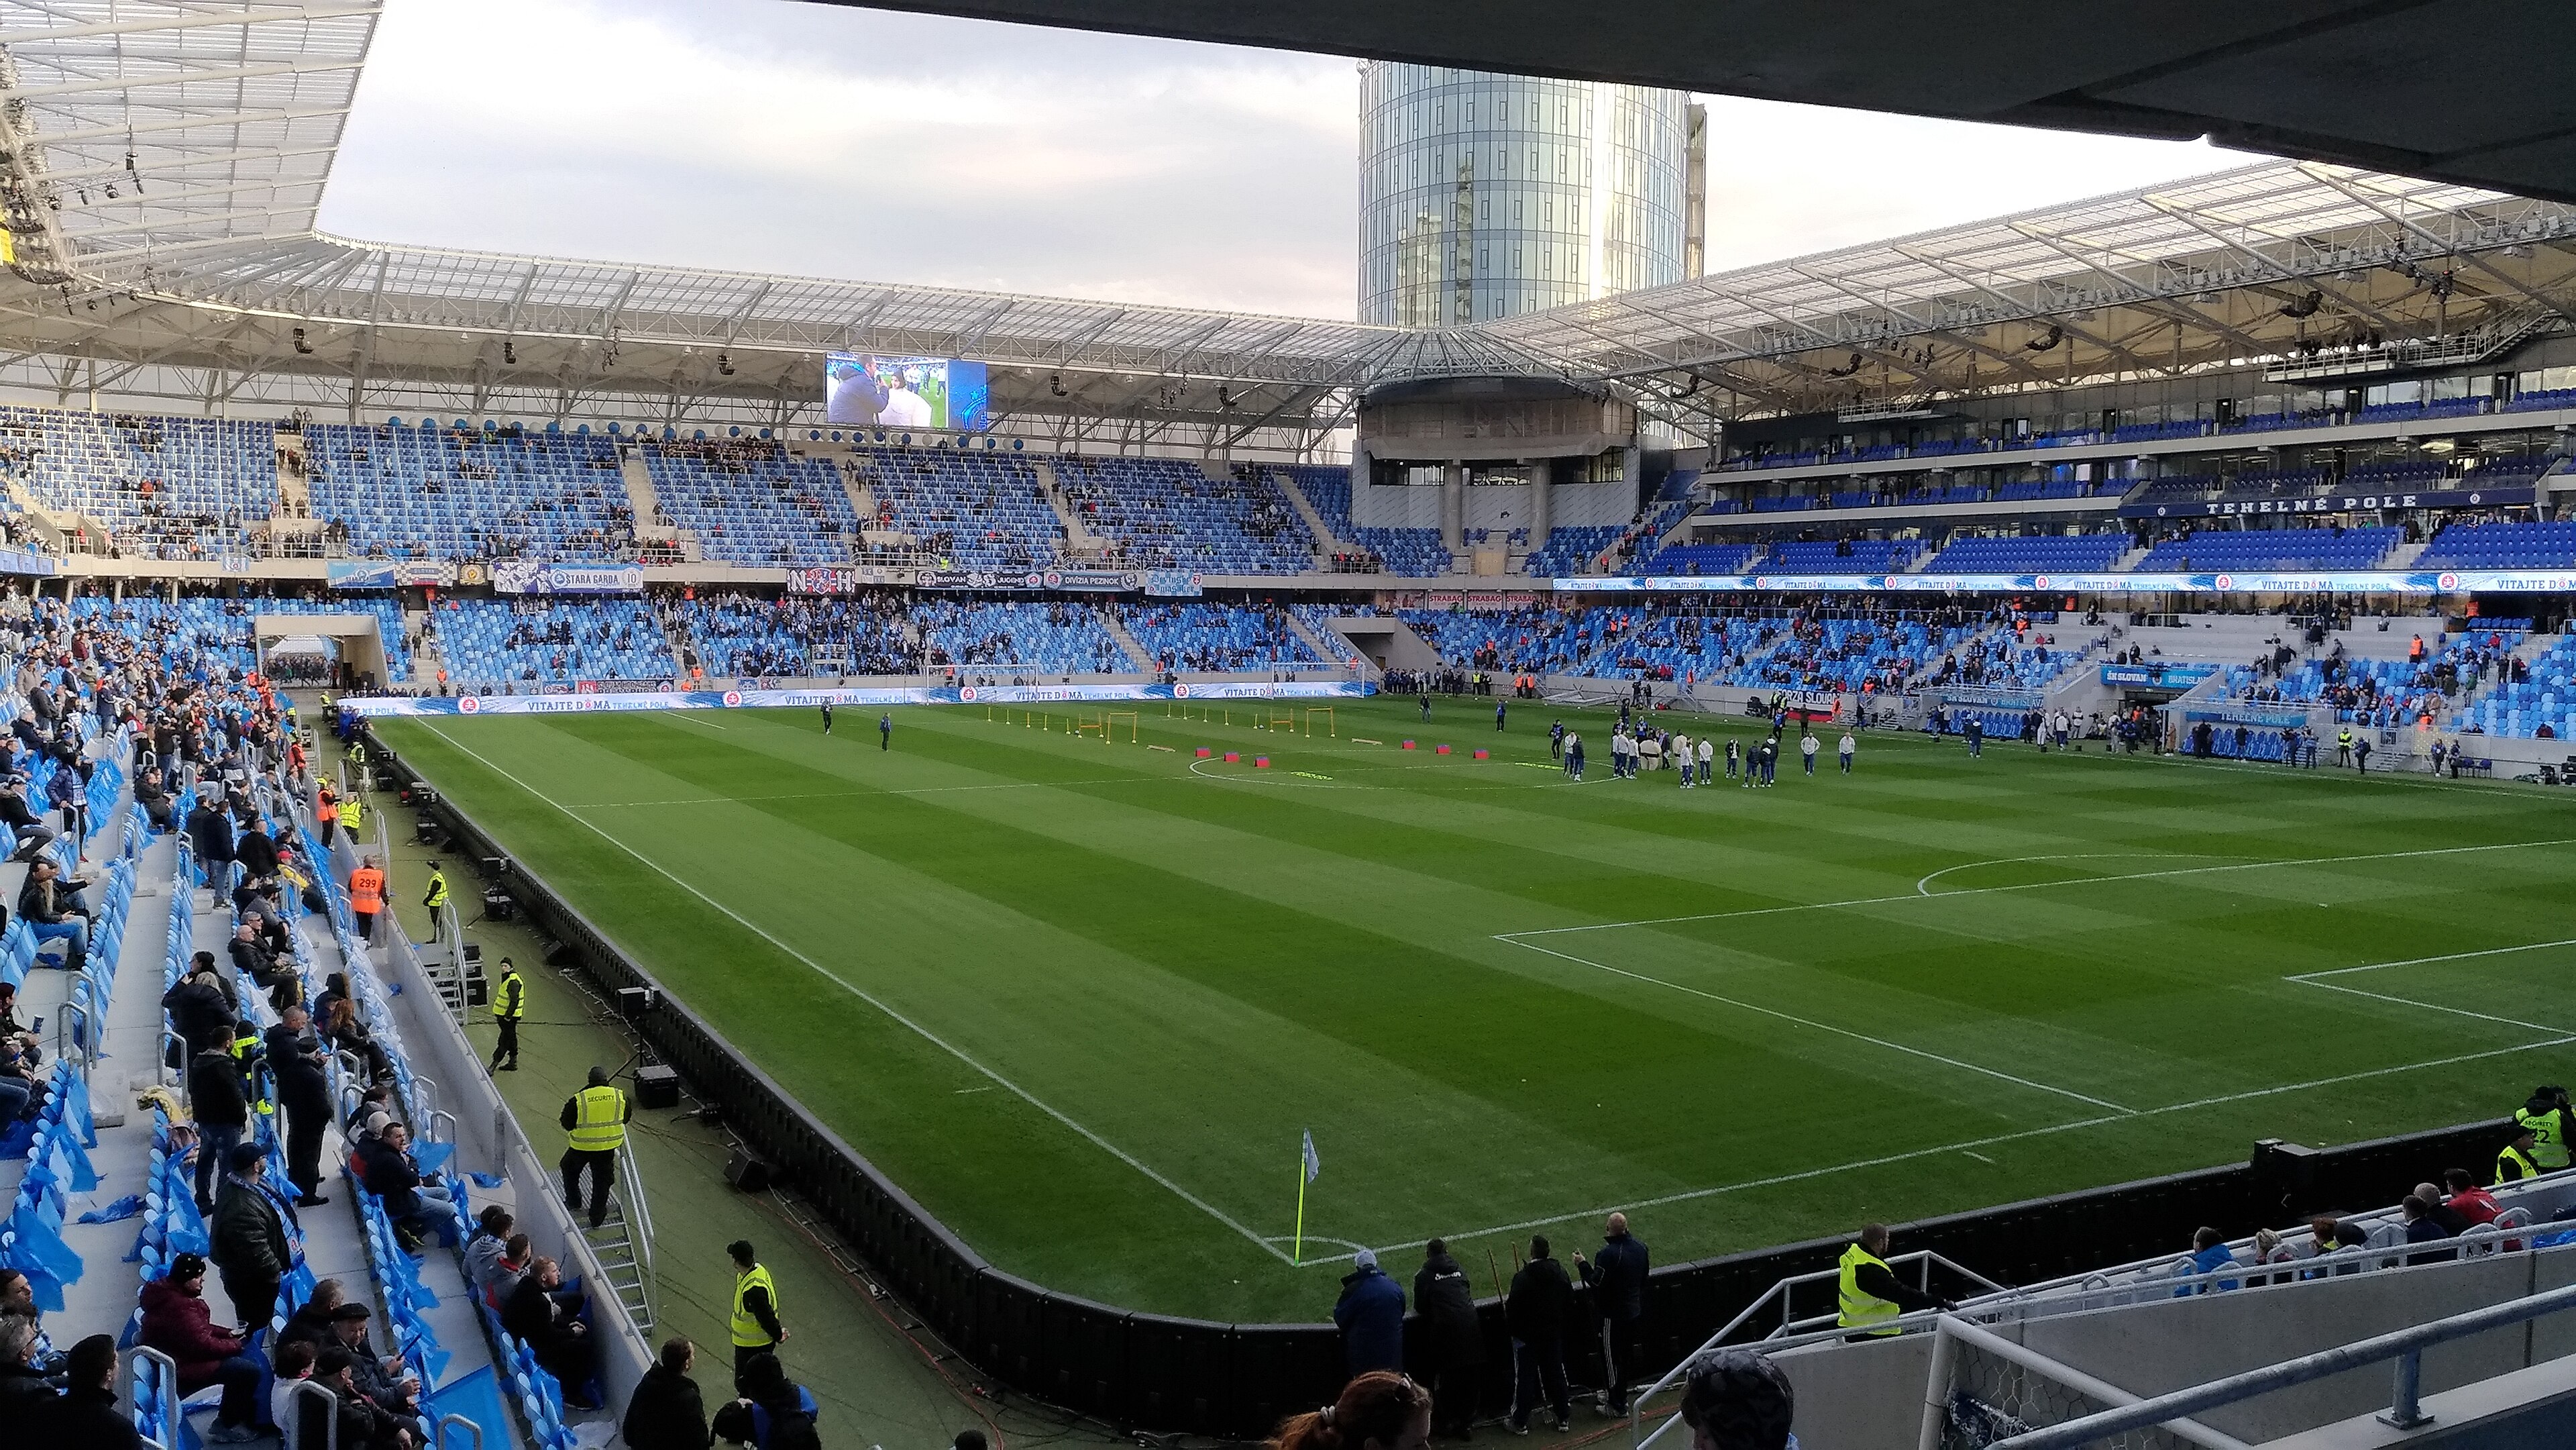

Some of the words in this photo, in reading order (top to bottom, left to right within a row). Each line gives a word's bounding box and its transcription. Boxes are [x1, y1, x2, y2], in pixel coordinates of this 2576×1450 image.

[2206, 498, 2327, 514] TEHELNÉ
[2343, 495, 2416, 509] POLE
[566, 572, 591, 584] STARÁ
[593, 574, 618, 583] GARDA
[627, 574, 637, 583] 10
[1065, 576, 1088, 584] DIVÍZIA
[1090, 576, 1118, 585] PEZINOK
[2262, 581, 2300, 590] VITAJTE
[2497, 580, 2544, 589] VITAJTE
[2118, 672, 2147, 682] SLOVAN
[1016, 691, 1052, 700] VITAJTE
[1224, 688, 1258, 696] VITAJTE
[528, 702, 573, 711] VITAJTE
[360, 878, 376, 888] 299
[588, 1094, 614, 1102] SECURITY
